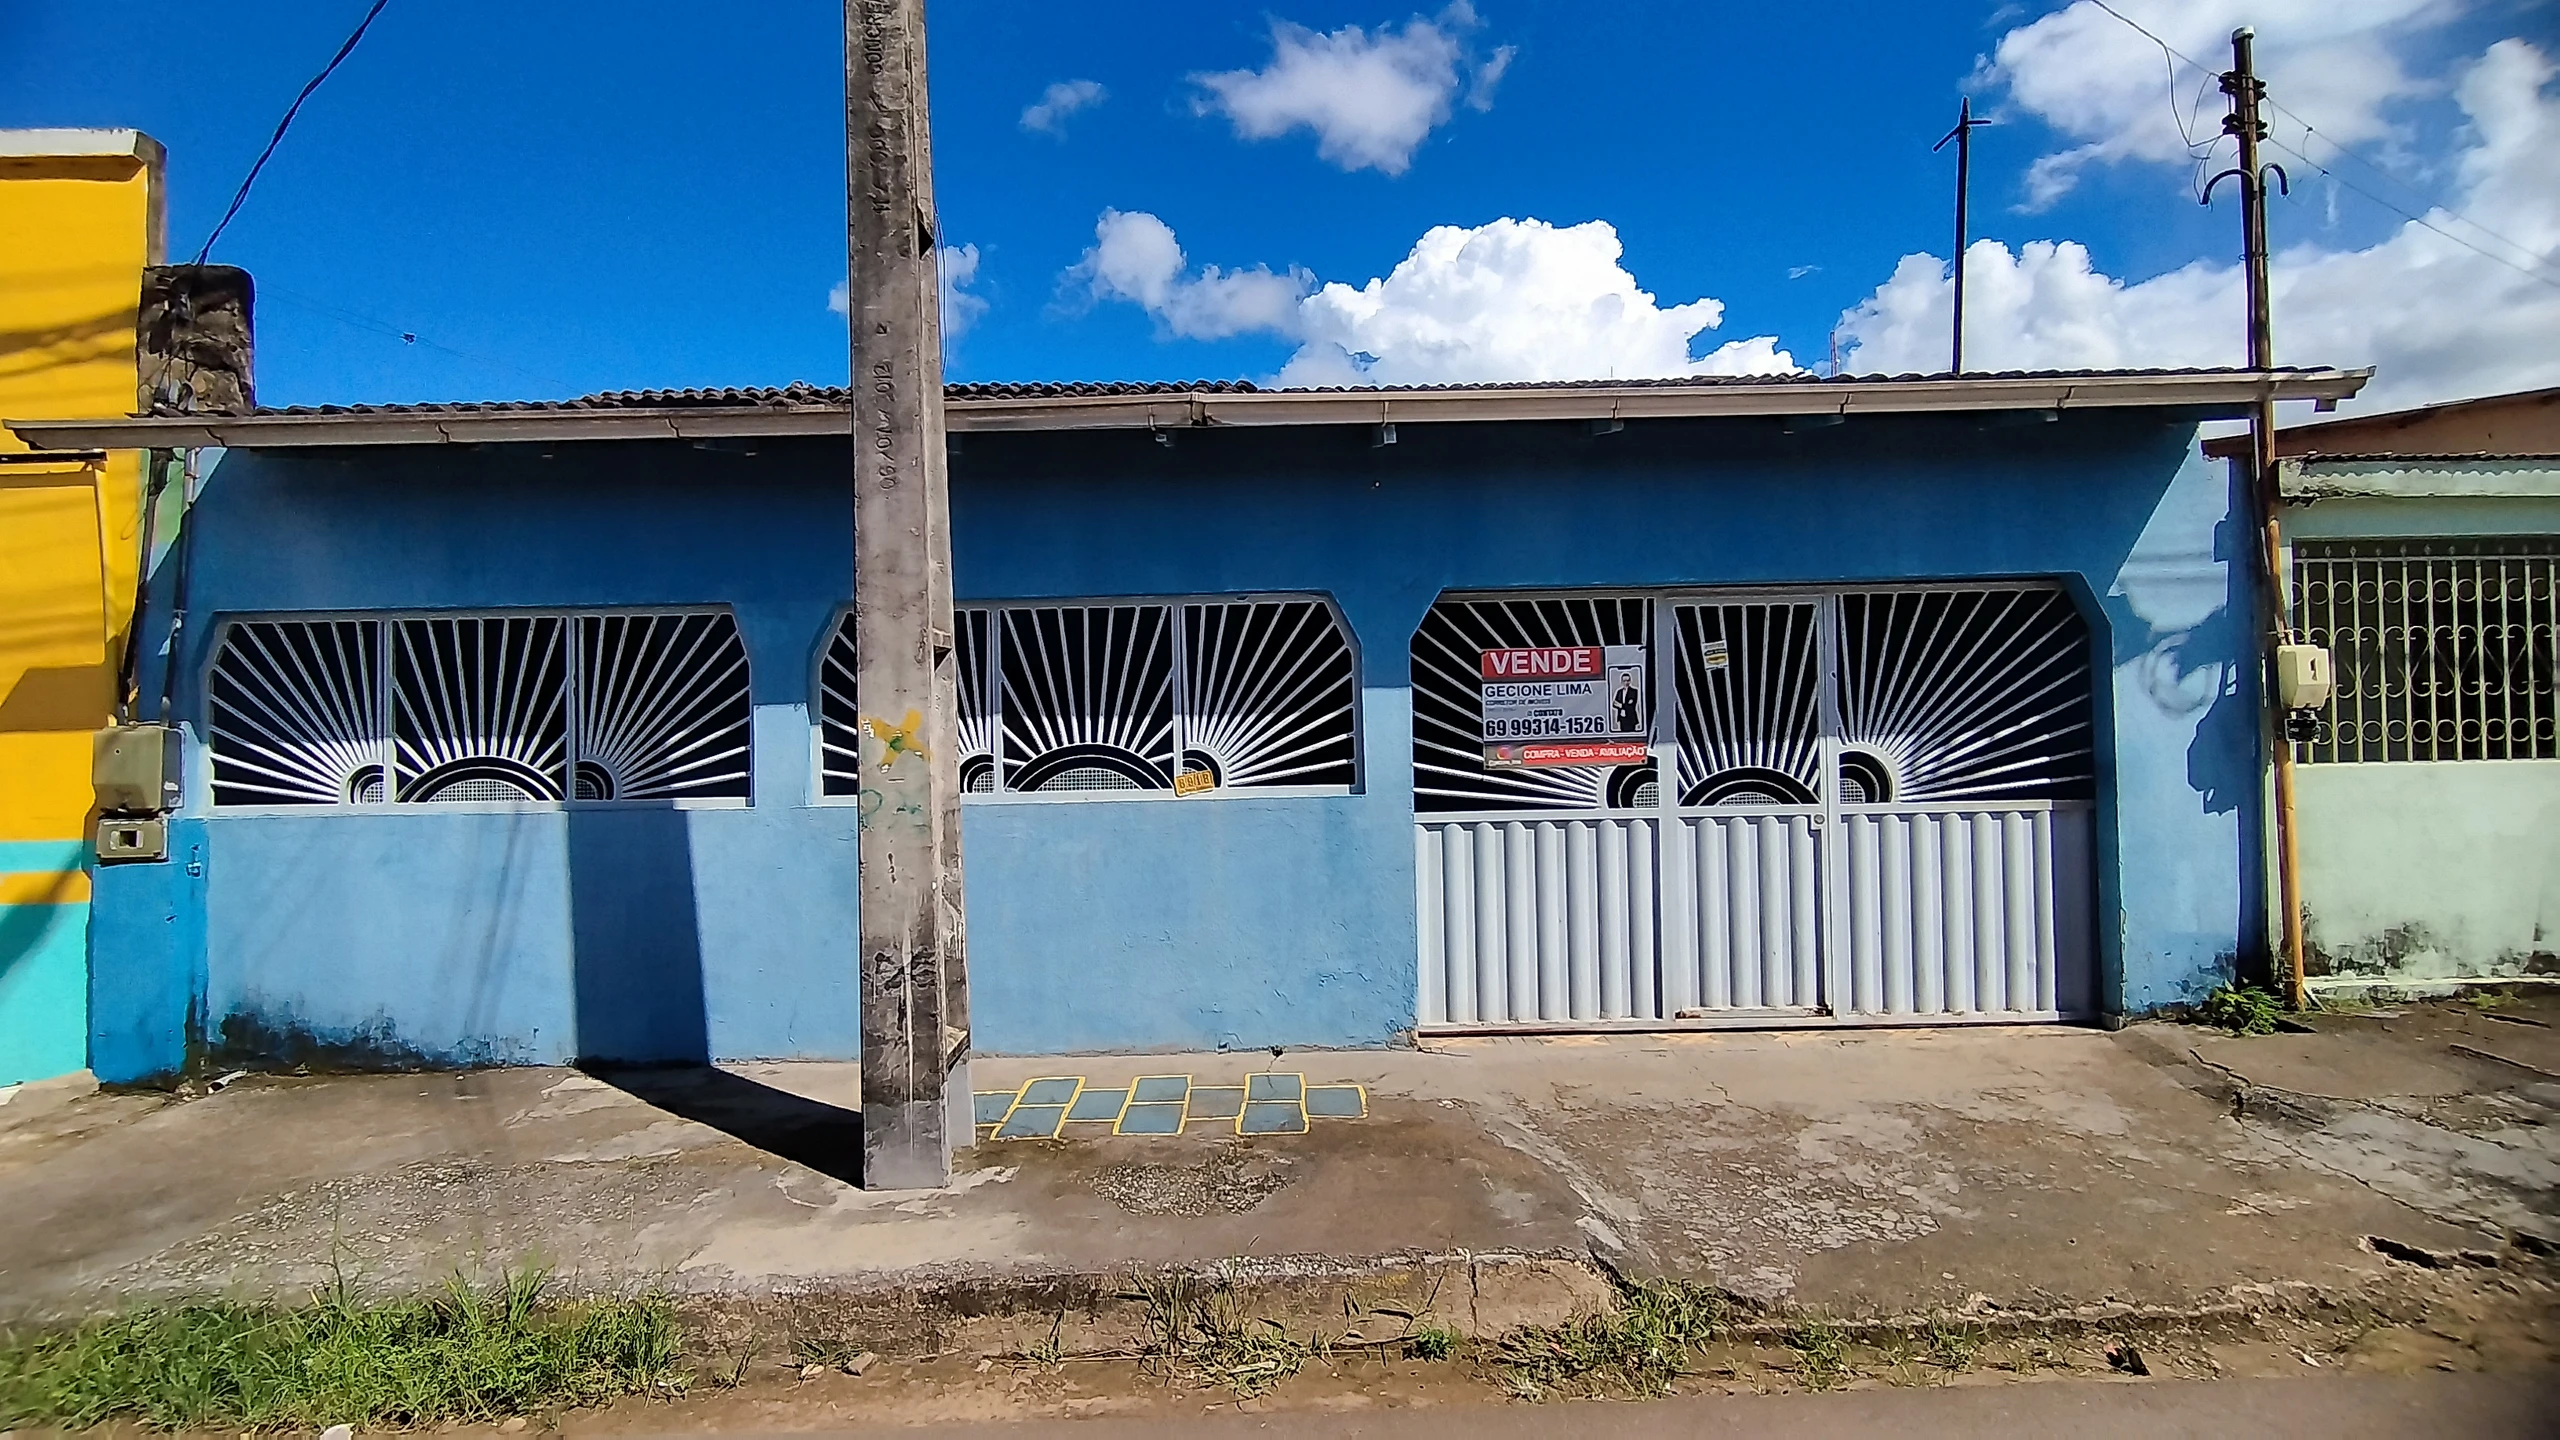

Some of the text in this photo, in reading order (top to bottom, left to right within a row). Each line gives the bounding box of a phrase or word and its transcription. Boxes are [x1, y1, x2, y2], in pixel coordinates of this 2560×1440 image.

[1490, 650, 1592, 675] VENDE
[1485, 683, 1593, 698] GECIONE LIMA
[1485, 716, 1605, 737] 69 99314-1526
[1523, 749, 1561, 759] COMPRA
[1565, 748, 1594, 758] VENDA
[1599, 745, 1645, 758] AVALIAÇÃO
